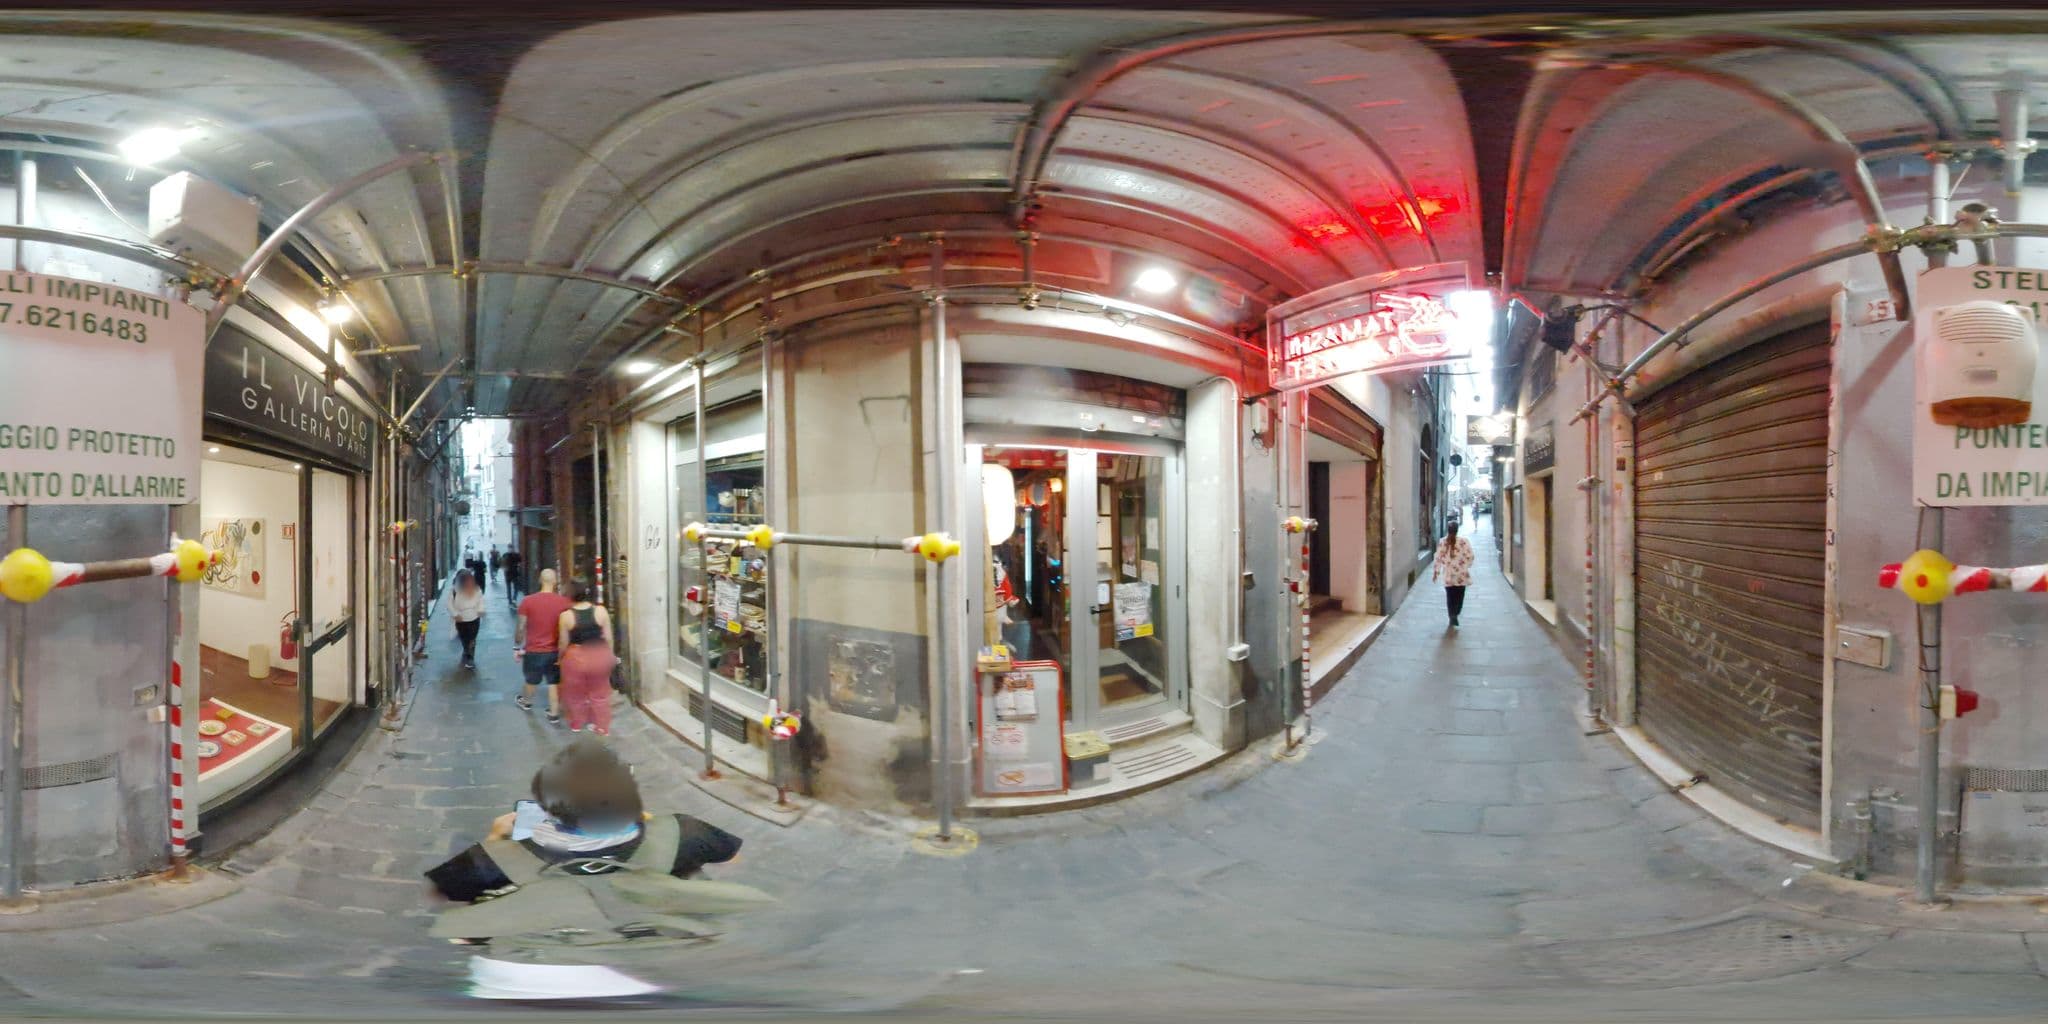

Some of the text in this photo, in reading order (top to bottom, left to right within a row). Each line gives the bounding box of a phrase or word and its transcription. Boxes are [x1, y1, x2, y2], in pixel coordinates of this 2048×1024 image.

[0, 274, 169, 320] LI IMPIANTI
[0, 302, 147, 344] 7.6216483
[242, 347, 367, 441] IL VICOLO
[0, 424, 176, 458] GGIO PROTETTO
[241, 387, 367, 459] GALLERIA D'ARTE
[1954, 423, 2048, 449] PONTE
[72, 473, 186, 498] D'ALLARME
[1936, 472, 1972, 498] DA
